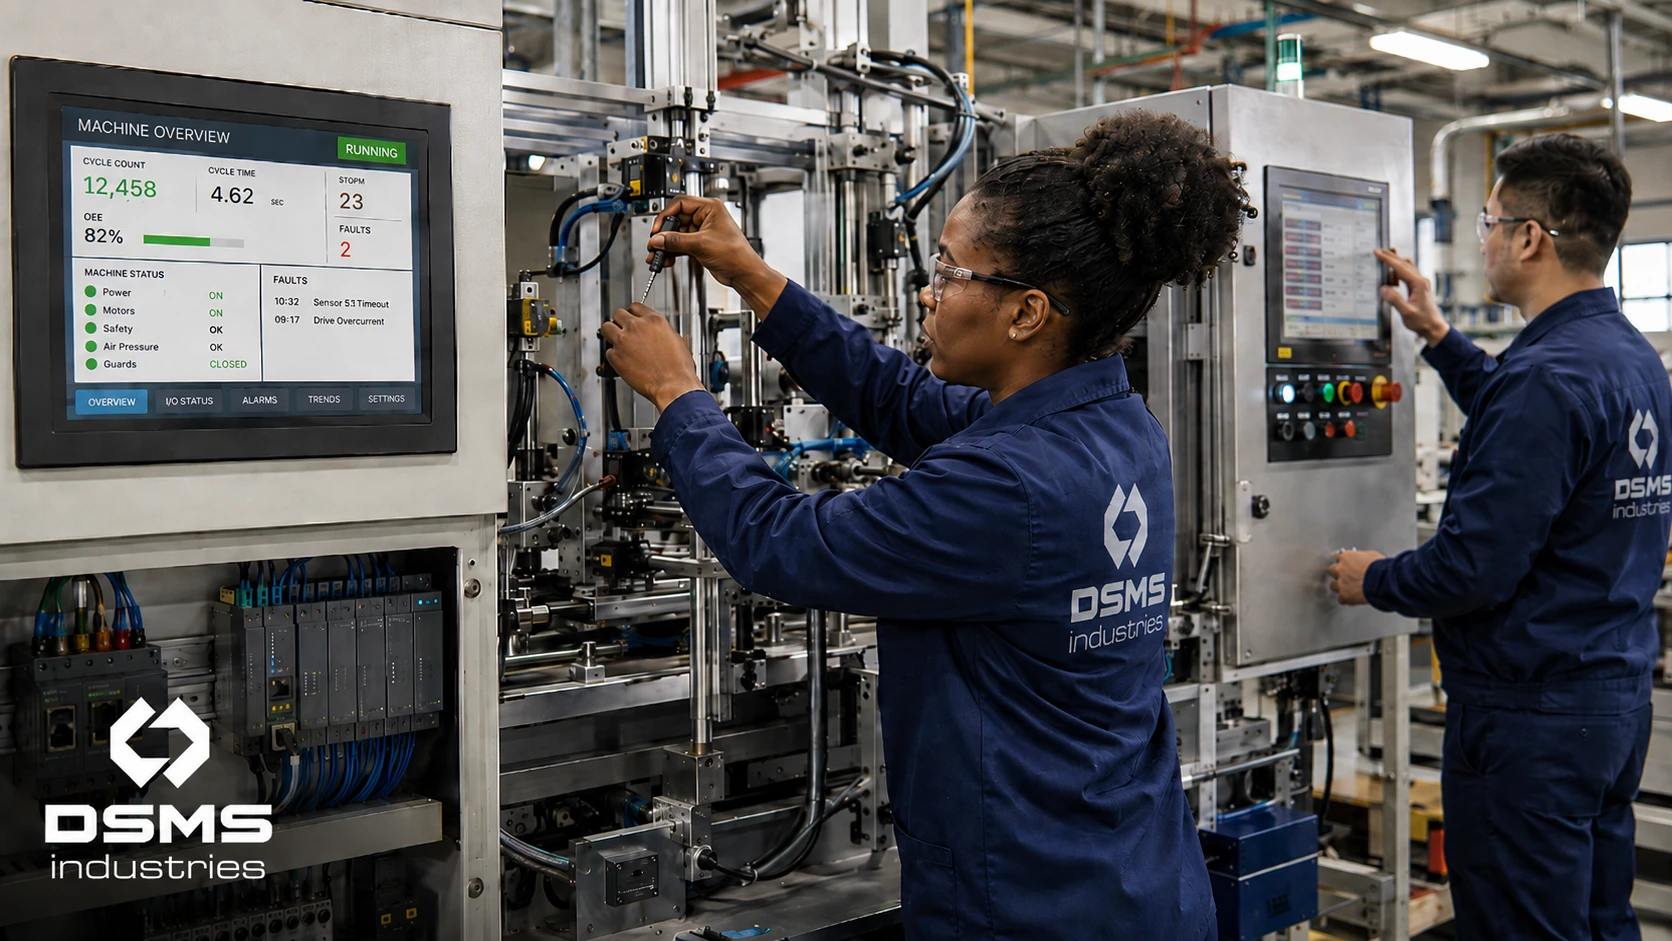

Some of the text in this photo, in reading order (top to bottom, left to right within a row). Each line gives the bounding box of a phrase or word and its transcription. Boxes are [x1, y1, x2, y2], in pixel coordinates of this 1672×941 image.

[78, 118, 230, 144] MACHINE OVERVIEW
[346, 144, 398, 158] RUNNING
[83, 157, 146, 168] CYCLE COUNT
[208, 166, 256, 177] CYCLE TIME
[338, 176, 365, 184] STOPM
[84, 176, 157, 199] 12,458
[211, 186, 254, 204] 4.62
[340, 192, 364, 210] 23
[84, 213, 103, 222] OEE
[340, 225, 371, 234] FAULTS
[84, 228, 124, 244] 82%
[340, 242, 351, 258] 2
[84, 268, 164, 278] MACHINE STATUS
[273, 276, 308, 284] FAULTS
[102, 288, 132, 296] Power
[274, 298, 300, 306] 10:32
[314, 298, 342, 307] Sensor
[356, 300, 390, 308] Timeout
[102, 306, 136, 315] Motors
[209, 309, 223, 317] ON
[274, 316, 384, 326] 09:17 Drive Overcurrent
[103, 324, 134, 335] Safety
[210, 326, 223, 334] OK
[103, 342, 159, 351] Air Pressure
[210, 344, 223, 352] OK
[104, 360, 137, 368] Guards
[210, 360, 248, 368] CLOSED
[88, 398, 136, 407] OVERVIEW
[166, 396, 214, 406] I/O STATUS
[242, 396, 278, 404] ALARMS
[308, 395, 340, 404] TRENDS
[368, 394, 405, 403] SETTINGS
[1614, 474, 1672, 500] DSMS
[1613, 499, 1670, 518] industries
[1070, 572, 1166, 624] DSMS
[1069, 614, 1163, 654] industries
